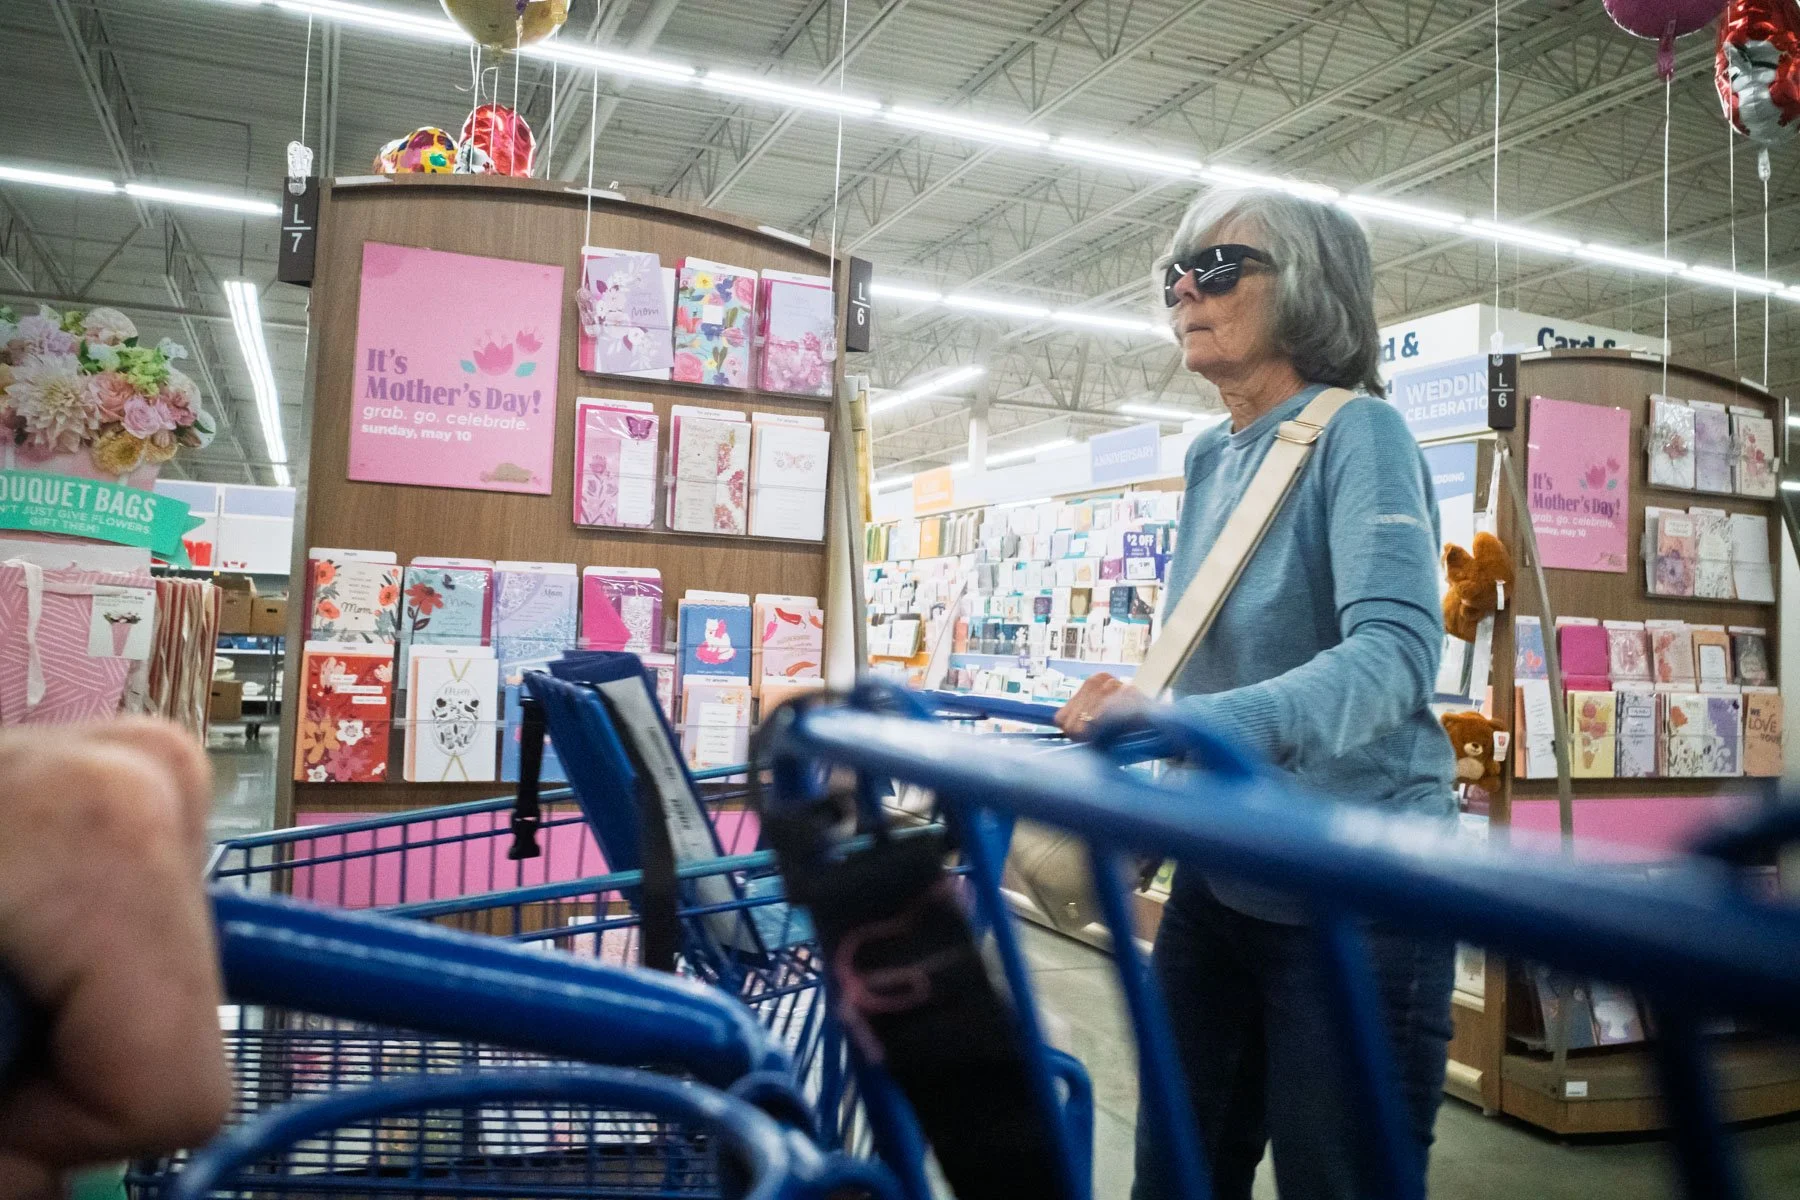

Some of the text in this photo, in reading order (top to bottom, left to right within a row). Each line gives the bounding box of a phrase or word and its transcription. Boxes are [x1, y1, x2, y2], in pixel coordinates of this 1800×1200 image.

[293, 203, 305, 224] L
[291, 232, 303, 253] 7
[858, 282, 867, 301] L
[857, 307, 865, 326] 6
[1405, 370, 1488, 406] WEDDIN
[1498, 372, 1508, 388] L
[364, 375, 542, 417] Mother's Day!
[1497, 392, 1507, 408] 6
[363, 405, 530, 431] grab. go. celebrate.
[1405, 394, 1488, 421] CELEBRATIO
[361, 423, 472, 442] sunday, may 10
[1432, 471, 1465, 485] EDDING
[0, 474, 157, 523] OUQUET BAGS
[22, 505, 55, 517] JUST
[57, 508, 89, 522] GIVE
[91, 514, 151, 535] FLOWERS
[1748, 715, 1777, 733] LOVE
